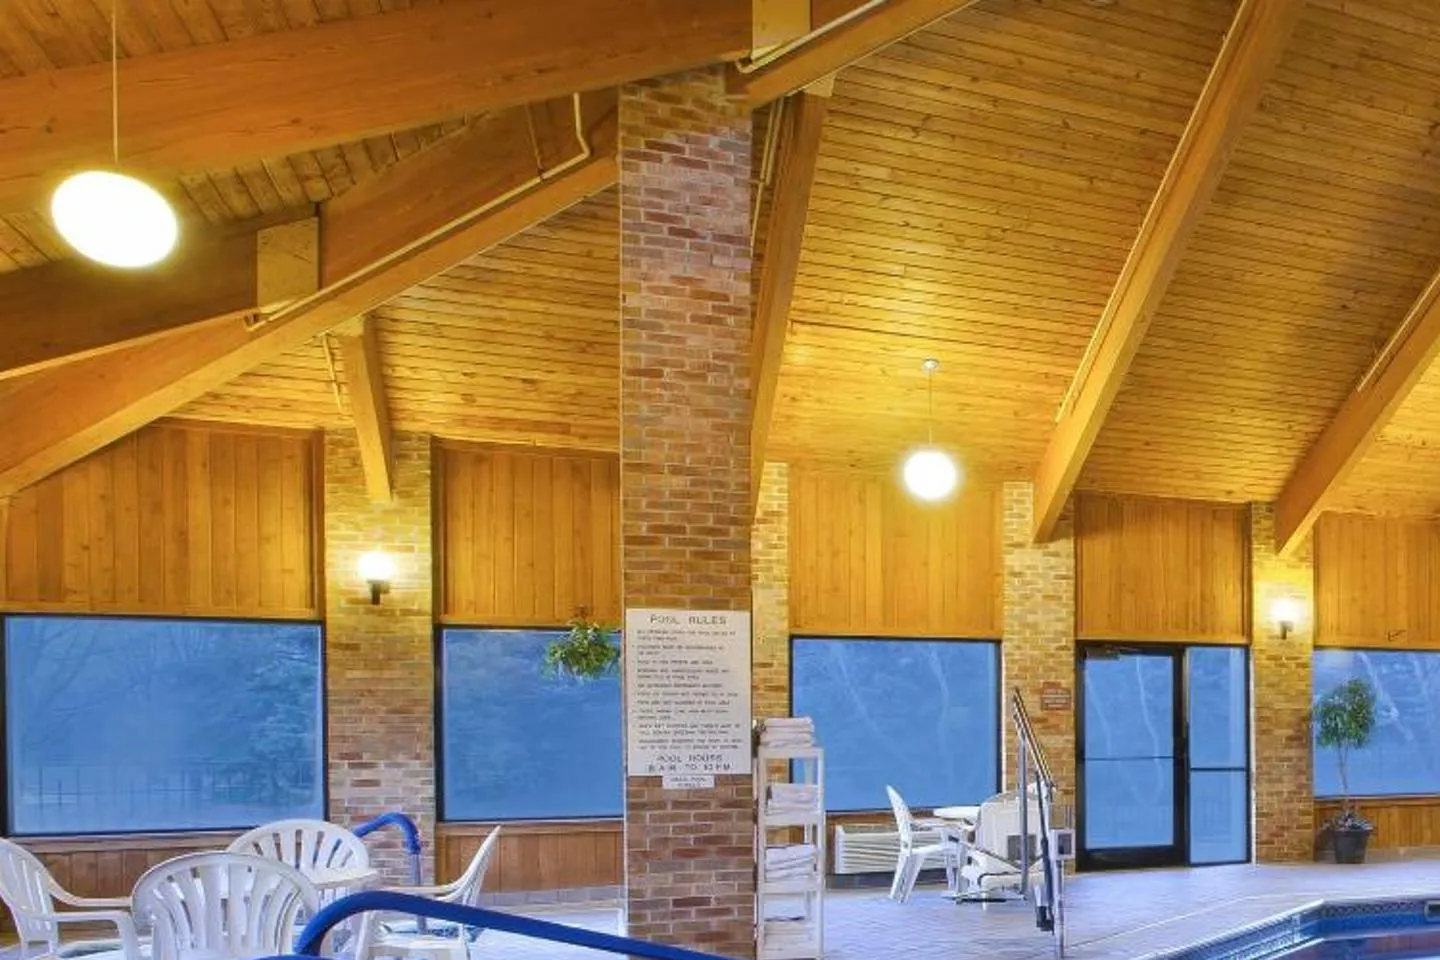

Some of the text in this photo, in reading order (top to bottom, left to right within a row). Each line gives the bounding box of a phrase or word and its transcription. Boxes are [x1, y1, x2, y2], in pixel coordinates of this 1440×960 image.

[650, 614, 727, 625] POOL RULES
[656, 753, 722, 763] POOL HOURS
